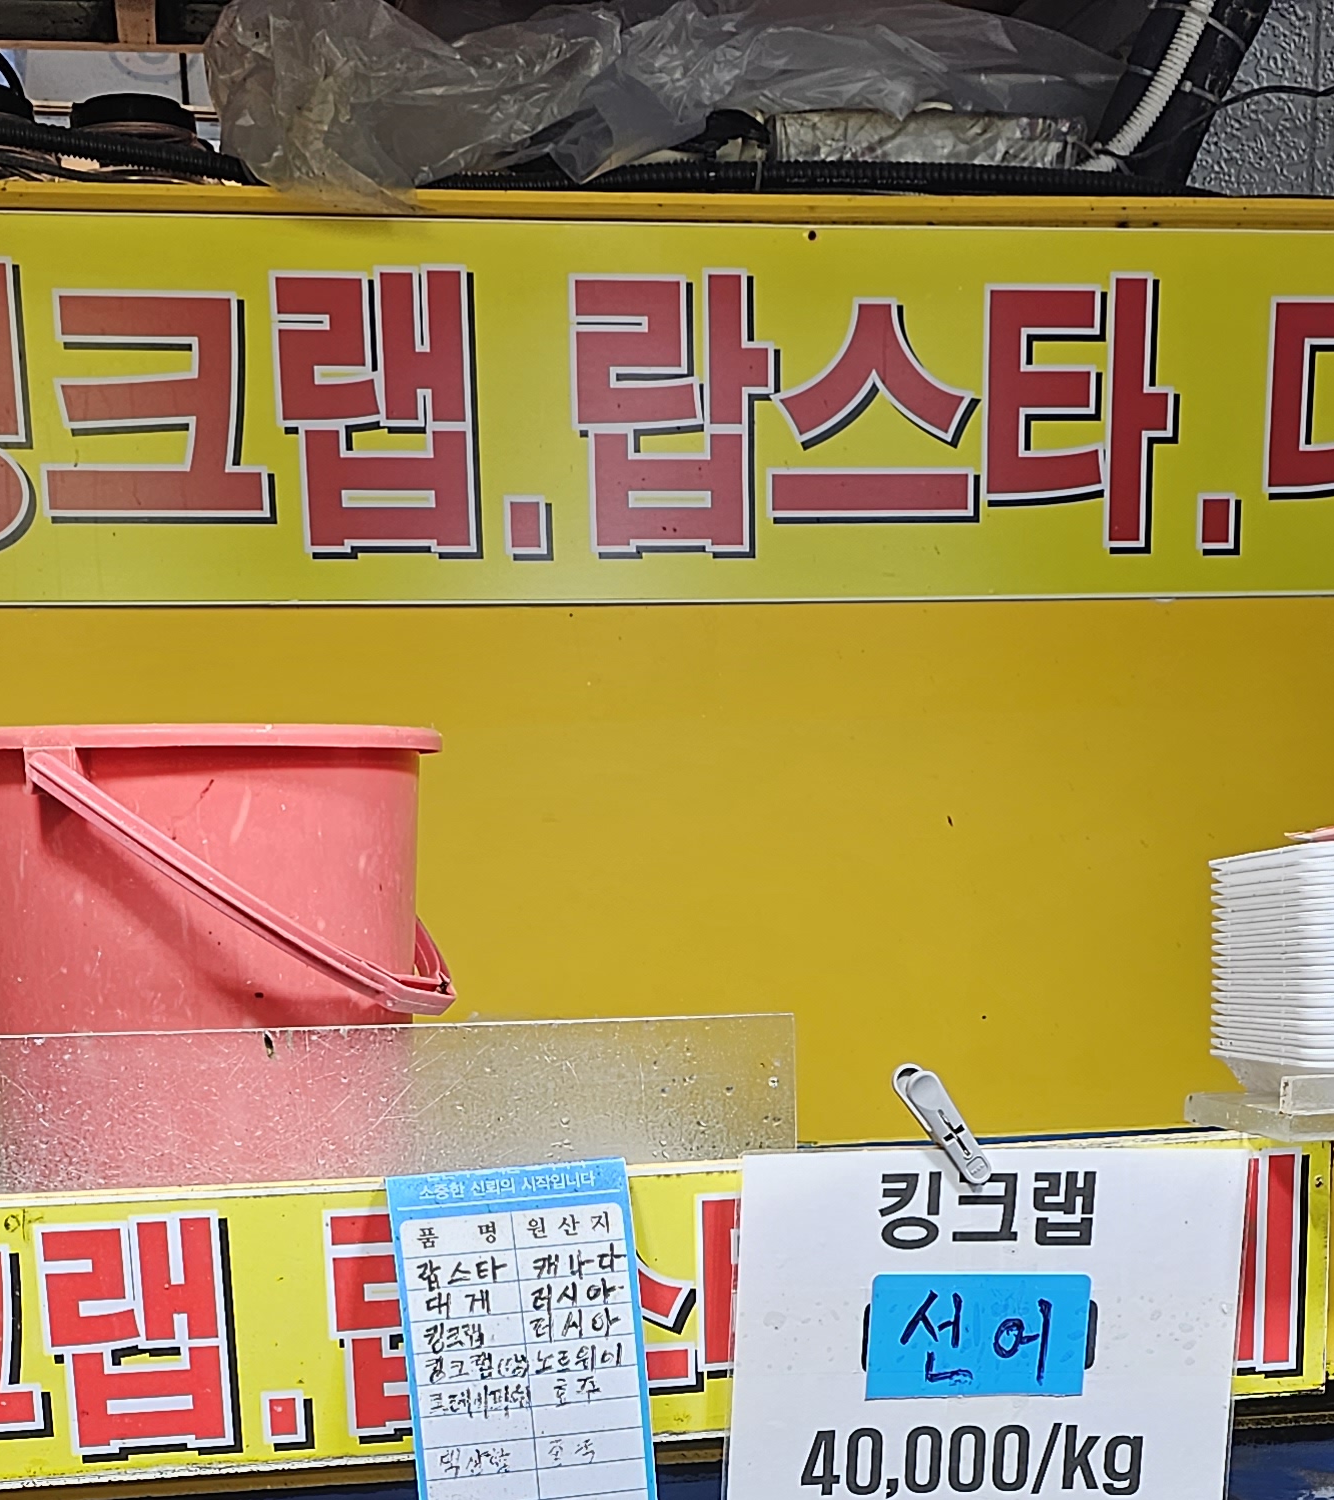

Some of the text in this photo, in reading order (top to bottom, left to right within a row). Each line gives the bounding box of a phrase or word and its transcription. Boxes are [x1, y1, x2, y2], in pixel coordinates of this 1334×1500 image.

[419, 1182, 465, 1200] 소중한
[470, 1177, 516, 1197] 신뢰의
[521, 1170, 596, 1192] 시작입니다
[878, 1171, 1097, 1249] 킹크랩
[899, 1289, 1054, 1386] 선어
[800, 1423, 1145, 1499] 40,000/kg
